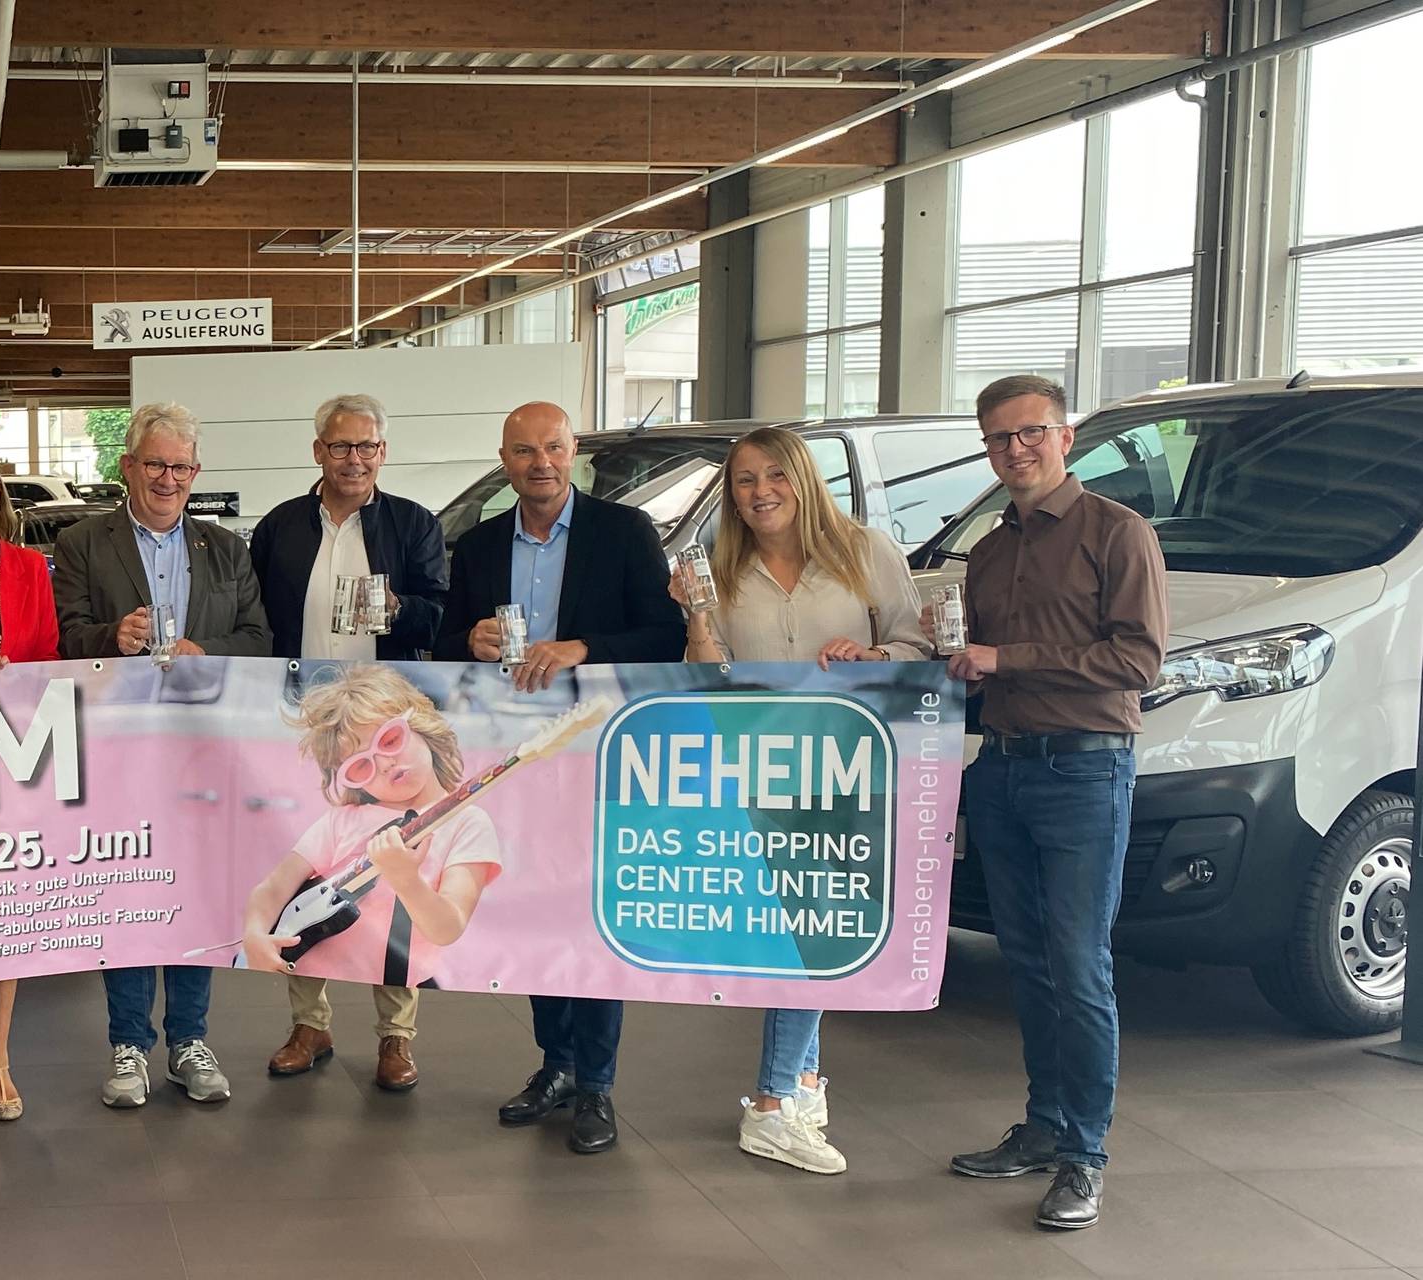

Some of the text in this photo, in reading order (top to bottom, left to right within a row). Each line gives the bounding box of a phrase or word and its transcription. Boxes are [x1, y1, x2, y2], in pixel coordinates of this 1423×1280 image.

[142, 307, 264, 321] PEUGEOT
[142, 324, 264, 339] AUSLIEFERUNG
[619, 734, 872, 811] NEHEIM
[66, 820, 151, 863] Juni
[617, 828, 871, 862] DAS SHOPPING
[908, 692, 941, 981] arnsberg-neheim.de
[21, 881, 30, 891] +
[36, 875, 67, 895] gute
[72, 867, 176, 888] Unterhaltung
[616, 864, 870, 900] CENTER UNTER
[66, 911, 110, 929] Music
[616, 901, 876, 938] FREIEM HIMMEL
[40, 932, 103, 951] Sonntag
